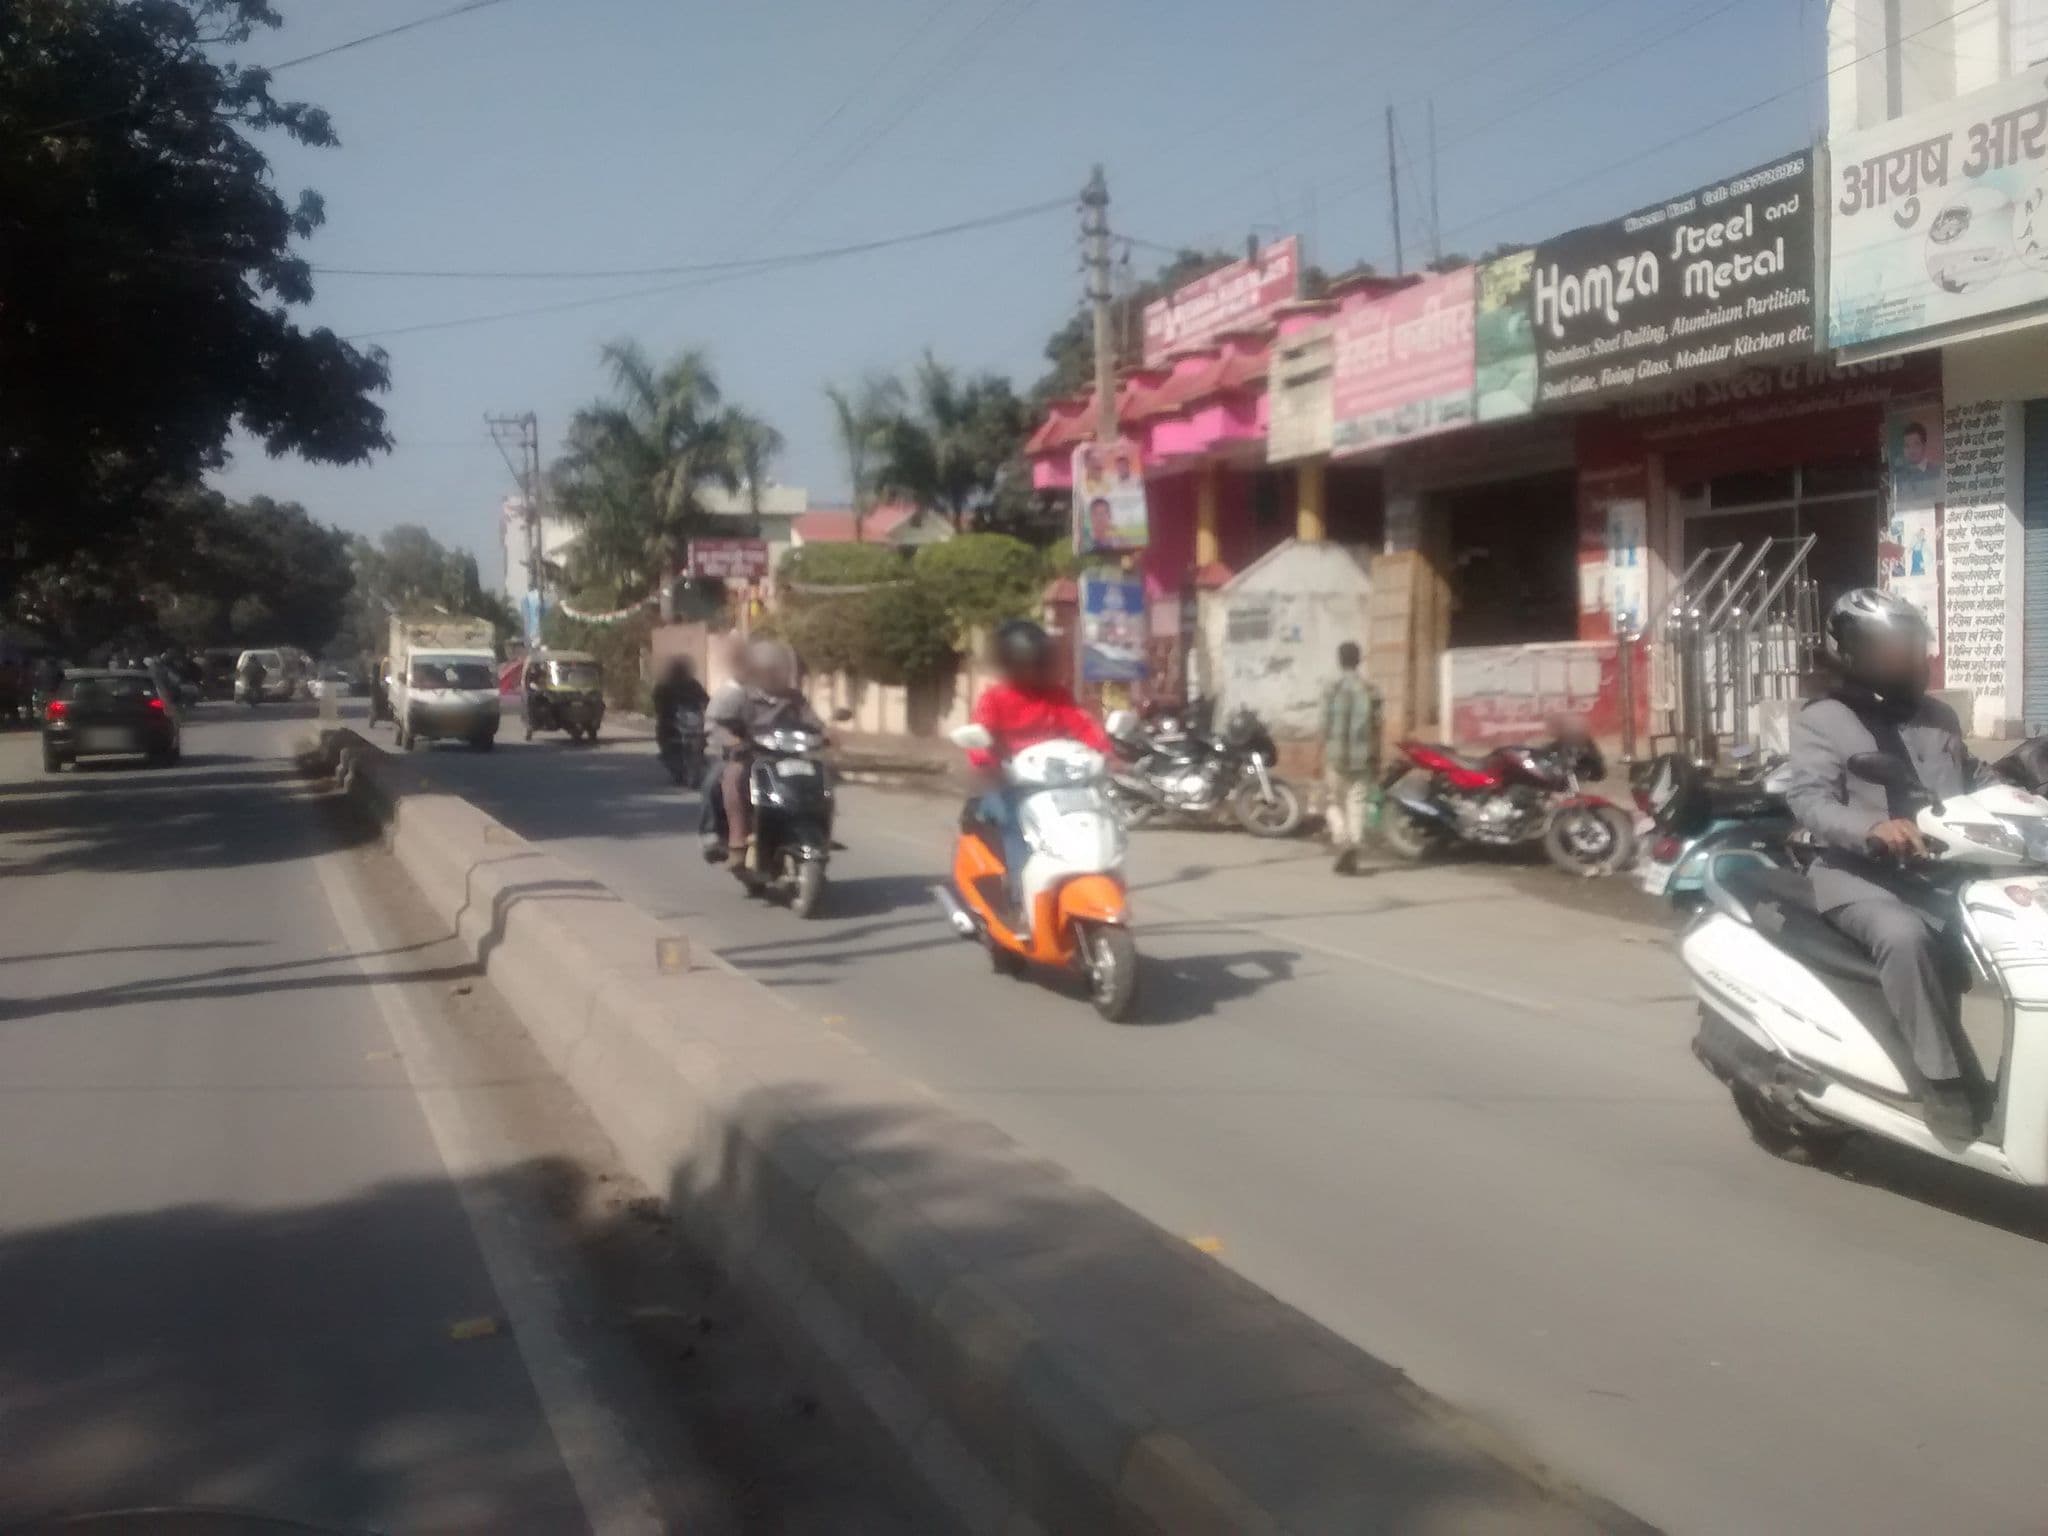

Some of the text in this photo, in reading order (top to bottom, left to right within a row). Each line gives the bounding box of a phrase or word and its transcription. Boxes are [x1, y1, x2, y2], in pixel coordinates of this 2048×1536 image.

[1839, 133, 1953, 229] आयुष
[1671, 203, 1753, 260] Steel
[1765, 194, 1800, 221] and
[1536, 251, 1659, 337] Hamza
[1684, 237, 1784, 299] Metal
[1671, 305, 1743, 337] Aluminium
[1746, 288, 1811, 318] Partition,
[1637, 359, 1672, 379] Glass,
[1675, 344, 1732, 370] Modular
[1734, 332, 1785, 358] Kitchen
[1788, 324, 1813, 344] etc.
